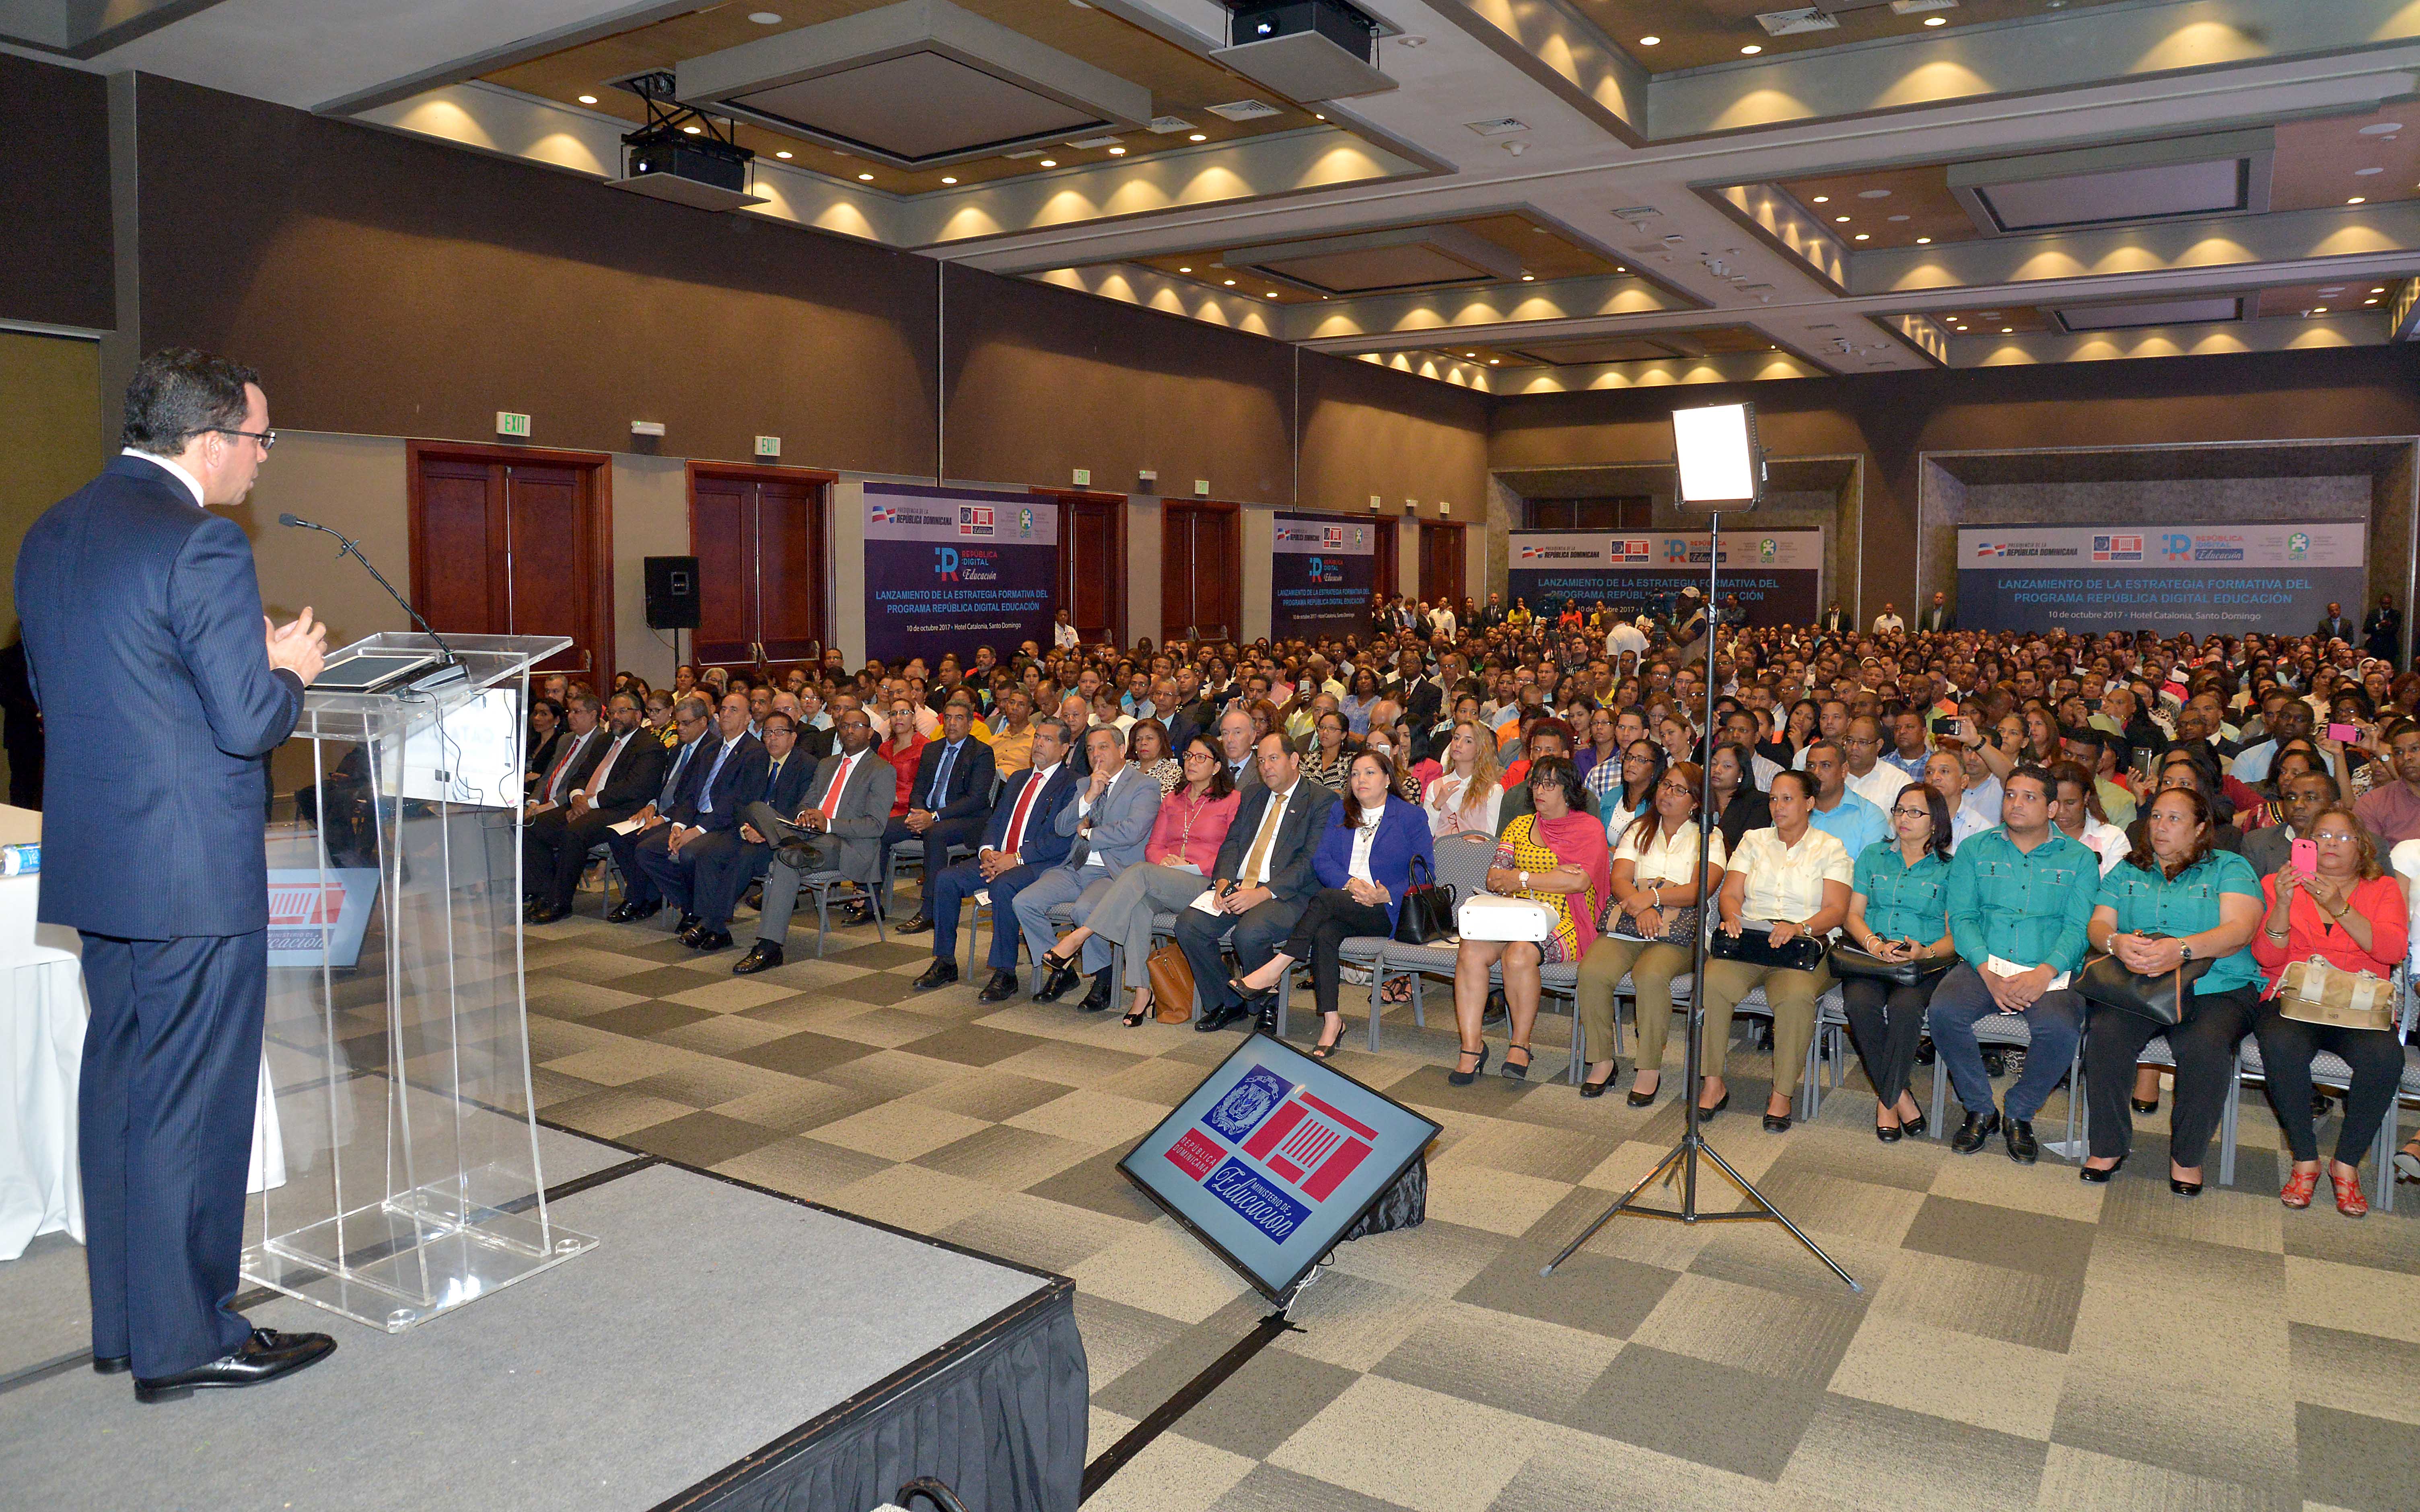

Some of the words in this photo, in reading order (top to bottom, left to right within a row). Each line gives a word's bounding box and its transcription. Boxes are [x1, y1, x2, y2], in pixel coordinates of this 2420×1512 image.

[505, 414, 525, 433] EXIT
[762, 438, 777, 454] EXIT
[896, 513, 922, 524] REPÚBLICA
[923, 516, 952, 526] DOMINICANA
[962, 549, 998, 558] REPÚBLICA
[2007, 547, 2038, 556] REPÚBLICA
[2196, 550, 2241, 560] Educación
[963, 568, 996, 580] Educación
[1637, 579, 1696, 587] ESTRATEGIA
[1759, 579, 1778, 588] DEL
[1998, 579, 2083, 589] LANZAMIENTO
[2086, 579, 2102, 589] DE
[2107, 579, 2122, 589] LA
[2126, 579, 2204, 589] ESTRATEGIA
[2208, 579, 2283, 590] FORMATIVA
[2286, 579, 2312, 590] DEL
[876, 591, 930, 600] LANZAMIENTO
[932, 591, 941, 599] DE
[943, 591, 953, 599] LA
[955, 590, 997, 598] ESTRATEGIA
[998, 590, 1035, 598] FORMATIVA
[1036, 590, 1048, 598] DEL
[2014, 593, 2083, 603] PROGRAMA
[2087, 591, 2158, 603] REPÚBLICA
[2162, 593, 2208, 603] DIGITAL
[2214, 592, 2292, 603] EDUCACIÓN
[887, 604, 930, 613] PROGRAMA
[933, 602, 973, 612] REPÚBLICA
[974, 603, 1000, 611] DIGITAL
[1002, 601, 1039, 611] EDUCACIÓN
[2154, 612, 2194, 620] Catalonia,
[2221, 612, 2261, 621] Domingo
[1180, 1137, 1216, 1166] REPÚBLICA
[1173, 1144, 1209, 1175] DOMINICANA
[1212, 1167, 1294, 1237] Educación
[1251, 1181, 1283, 1207] MINISTERIO
[1281, 1202, 1291, 1214] DE
